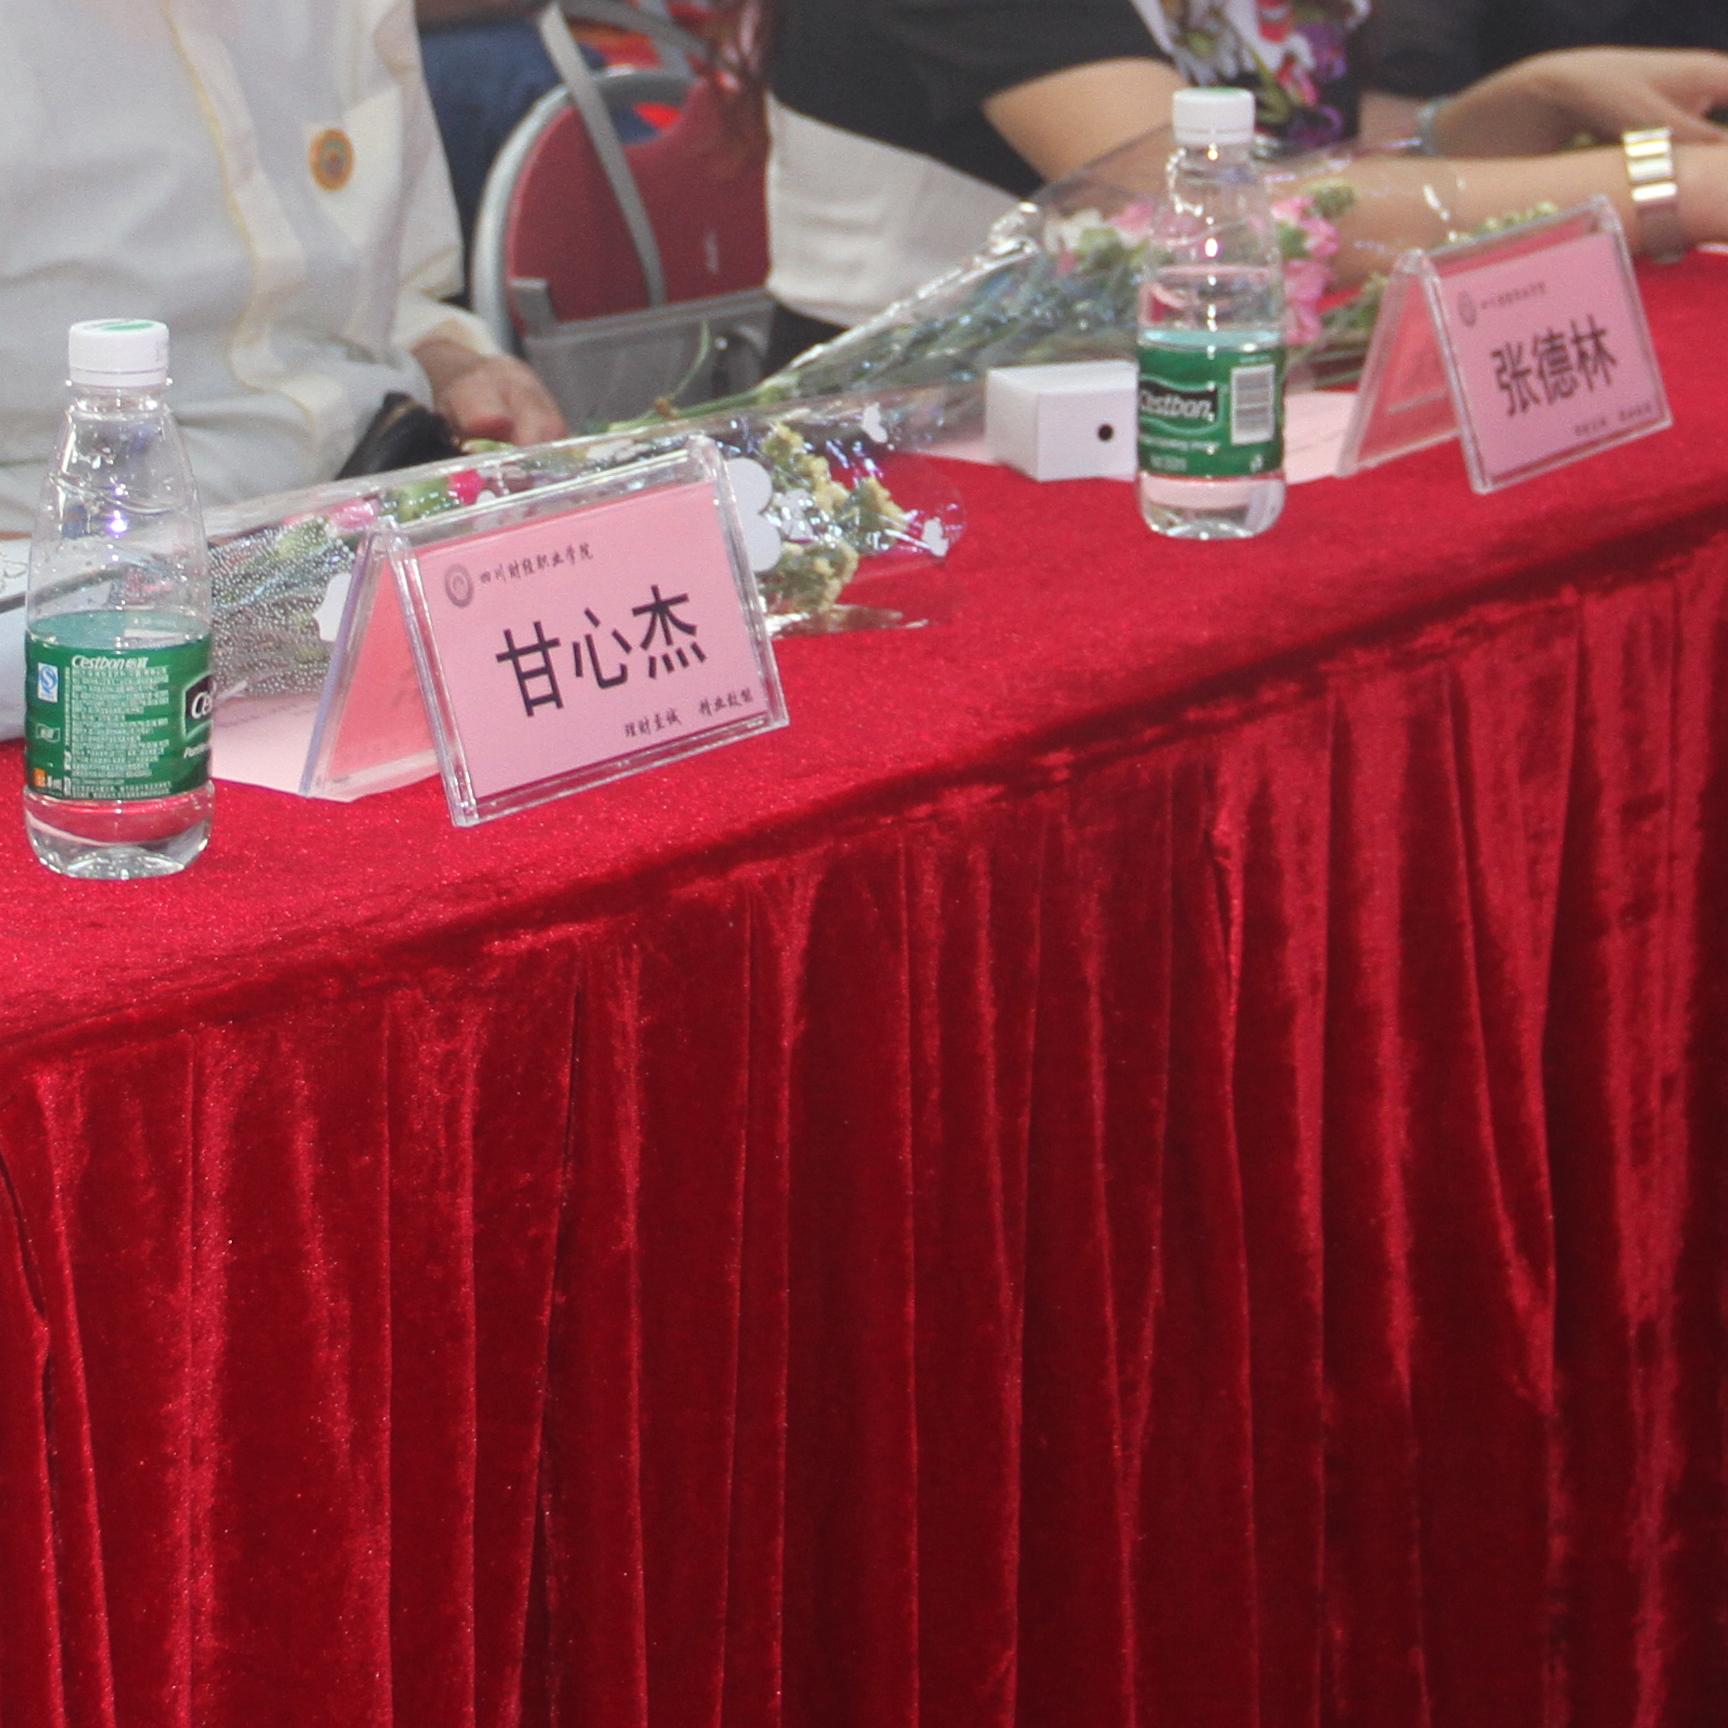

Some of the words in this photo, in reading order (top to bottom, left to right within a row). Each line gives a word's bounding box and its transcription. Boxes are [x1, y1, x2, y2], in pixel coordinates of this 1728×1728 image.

[1490, 313, 1617, 417] 张德林
[495, 584, 707, 717] 甘心杰
